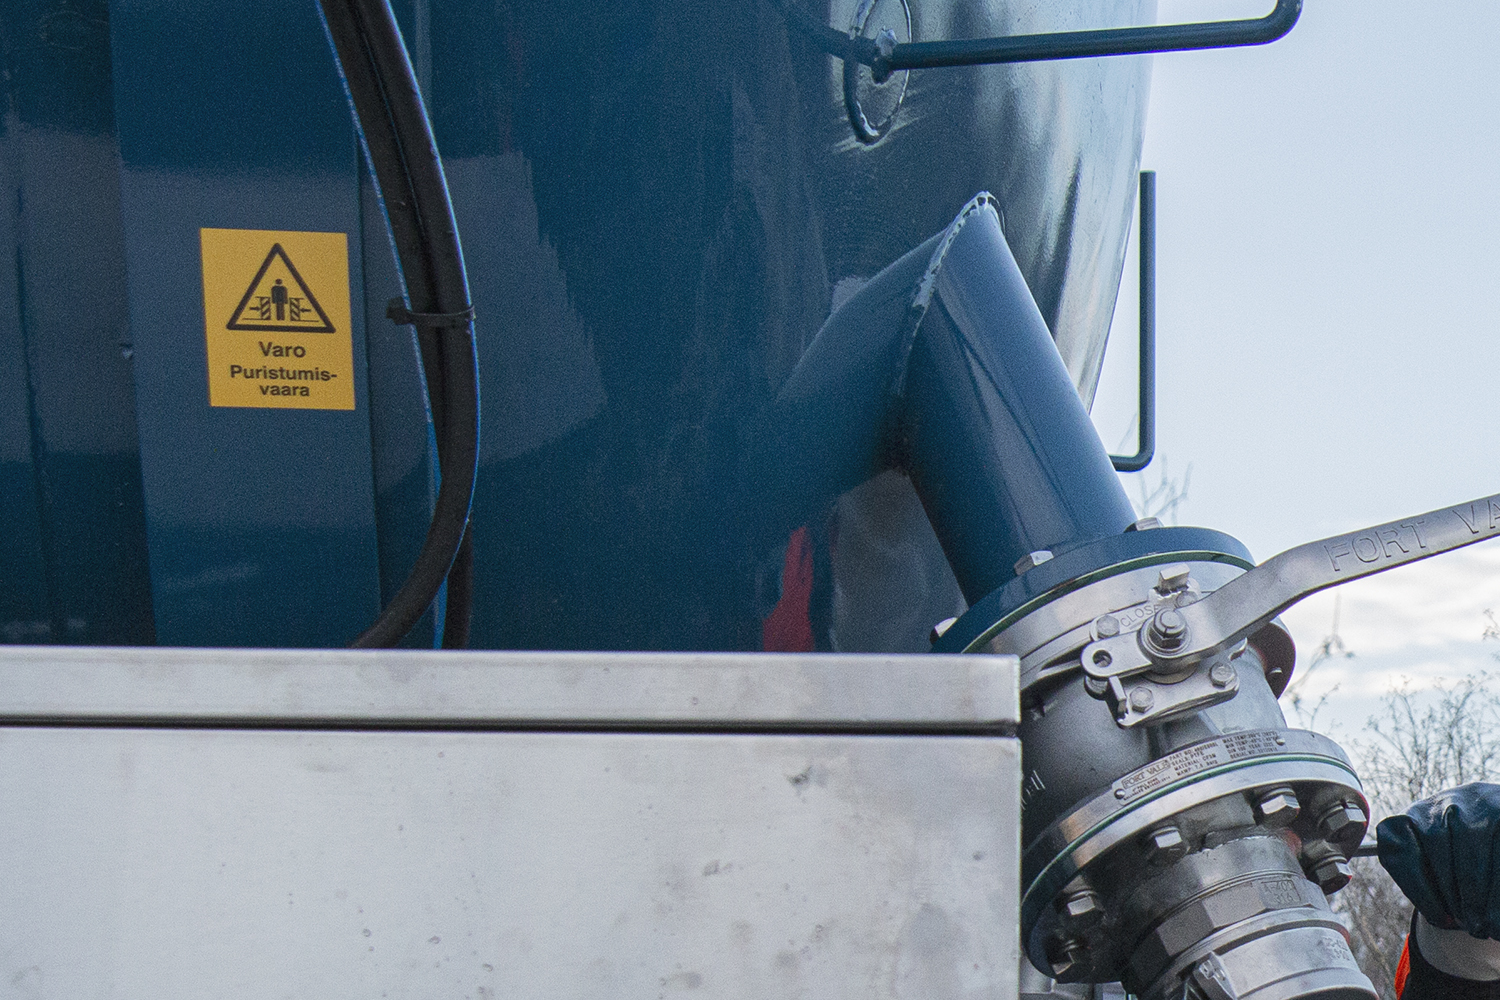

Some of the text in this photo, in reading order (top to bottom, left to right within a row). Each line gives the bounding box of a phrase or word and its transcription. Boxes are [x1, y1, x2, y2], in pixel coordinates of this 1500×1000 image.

[258, 341, 306, 358] Varo
[230, 365, 337, 382] Puristumis-
[260, 384, 310, 396] vaara
[1324, 520, 1426, 572] FORT
[1124, 761, 1170, 786] FORT VALE
